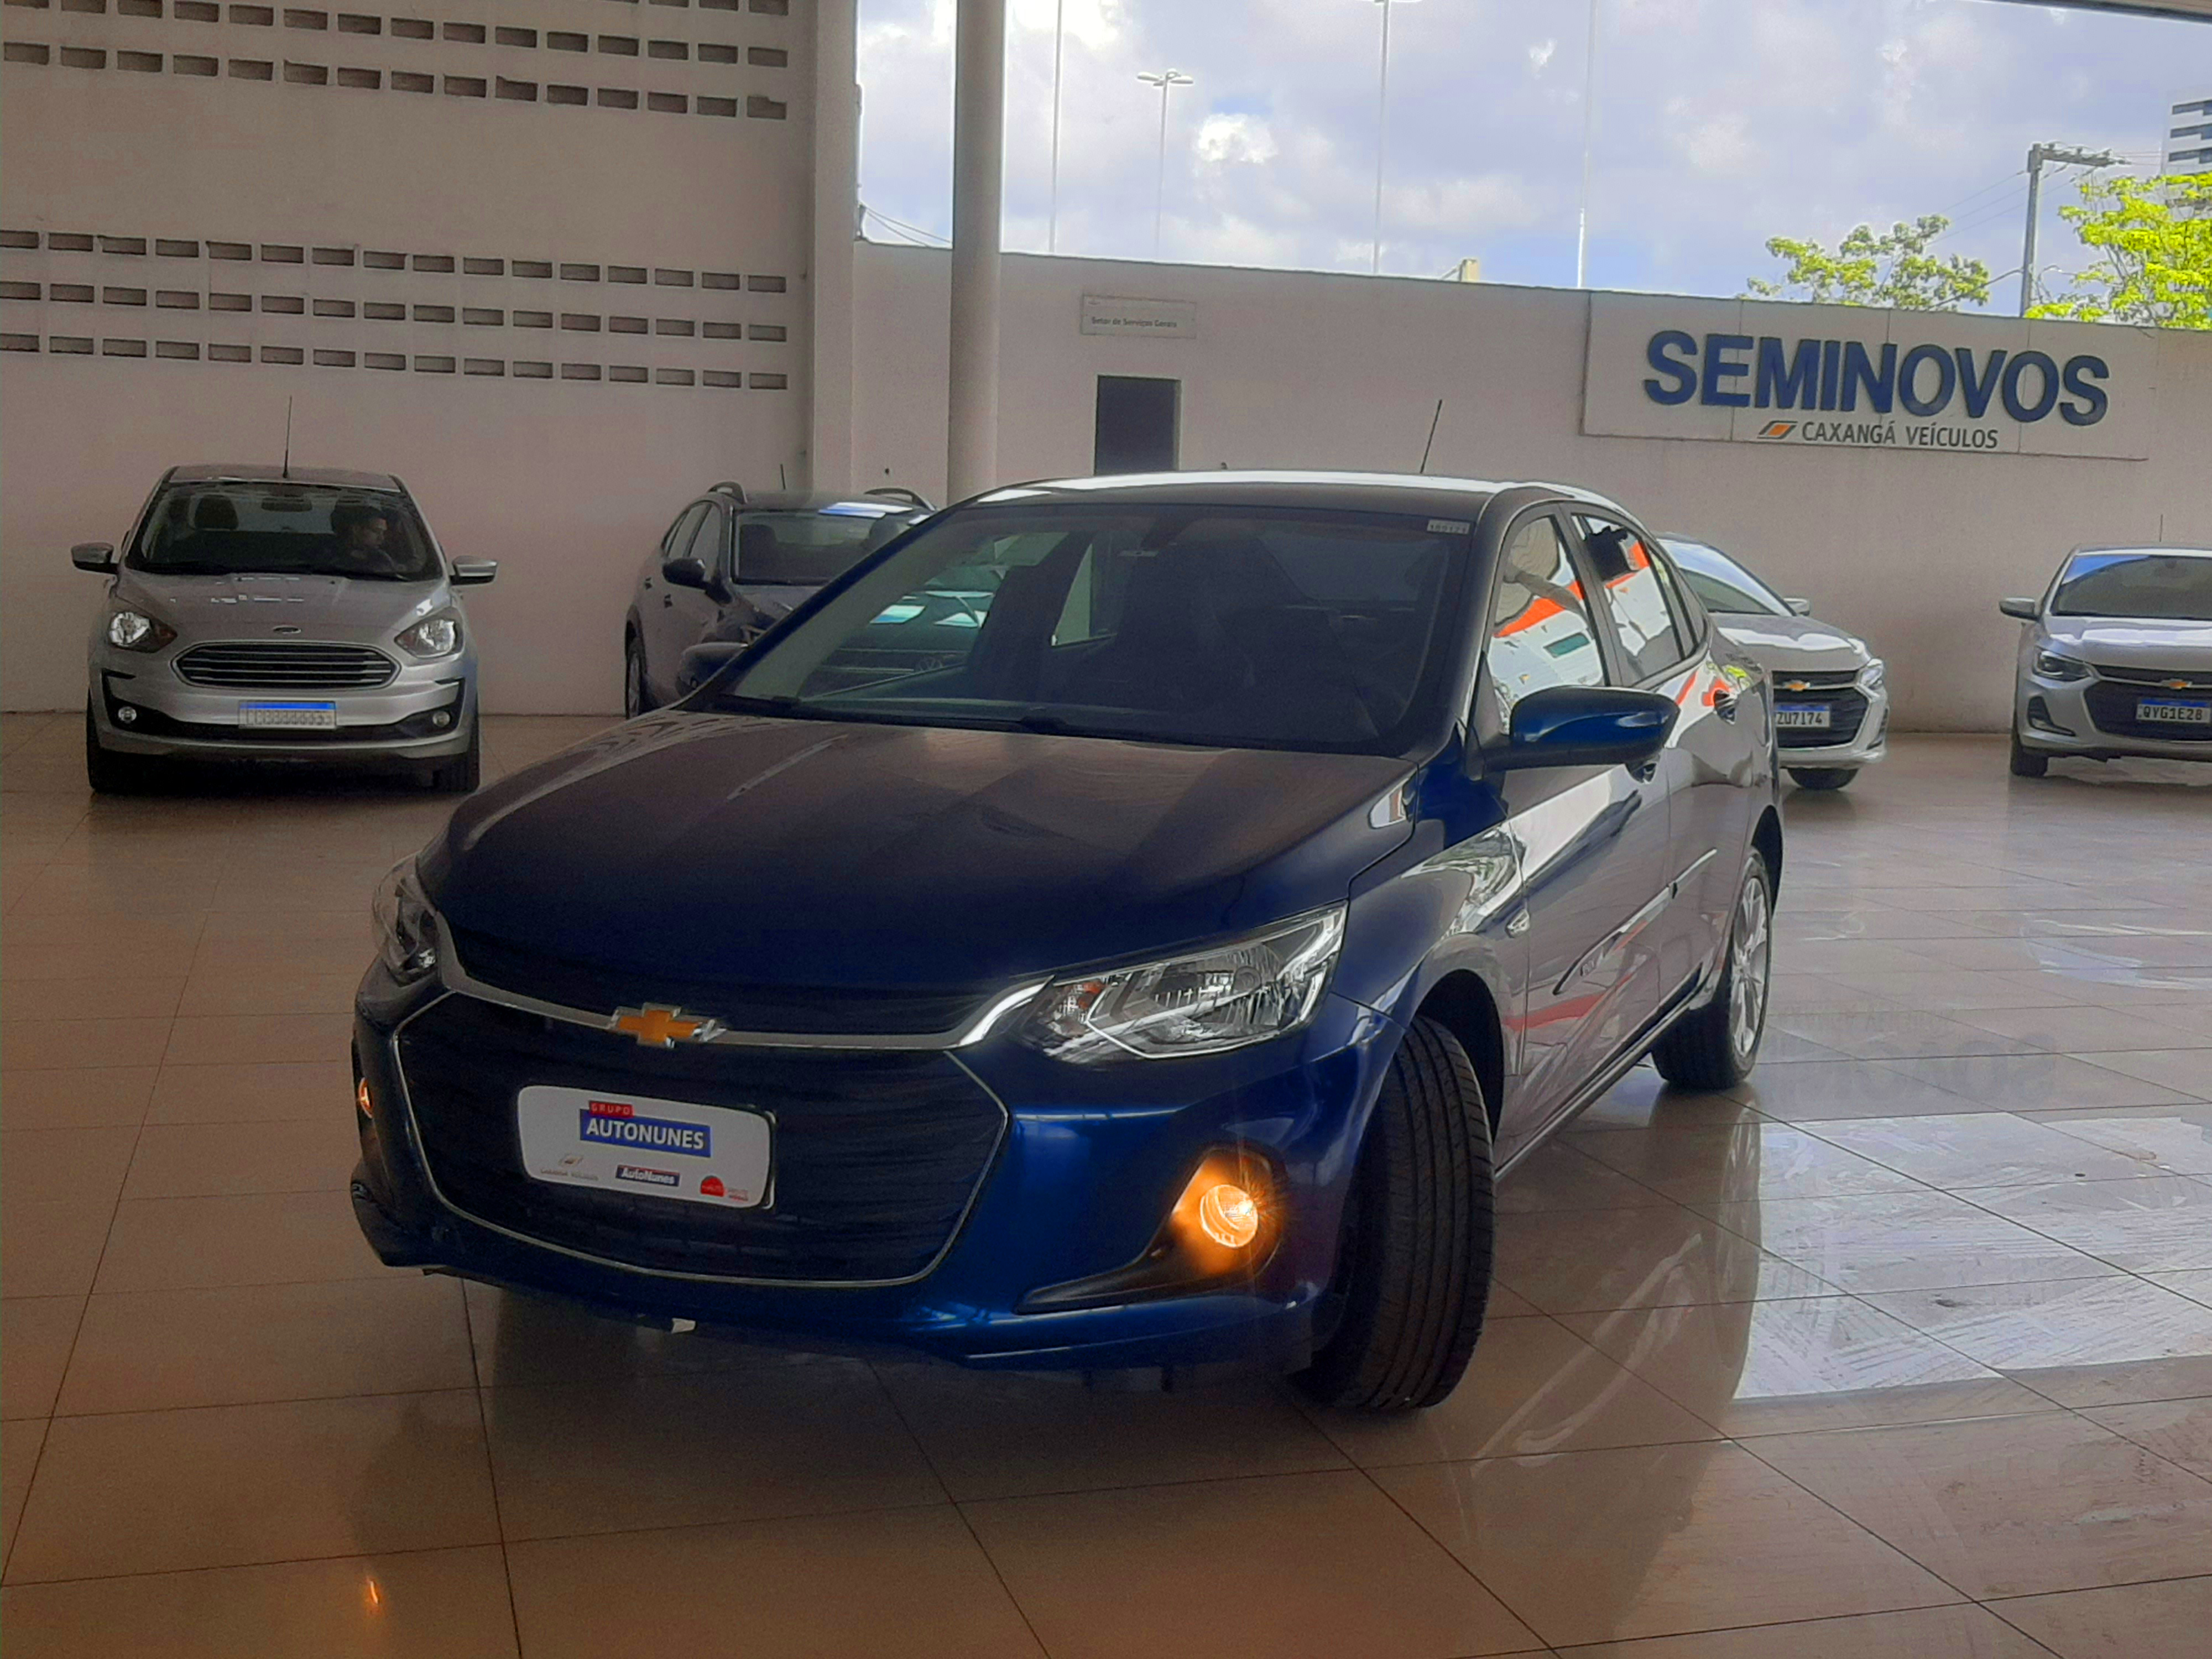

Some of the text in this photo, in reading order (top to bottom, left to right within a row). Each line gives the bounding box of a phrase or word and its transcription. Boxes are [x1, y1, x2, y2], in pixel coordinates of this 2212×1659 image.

[1091, 316, 1111, 325] Setor
[1112, 317, 1121, 326] de
[1643, 330, 2110, 426] SEMINOVOS
[1802, 419, 1999, 449] CAXANGÁ VEÍCULOS
[591, 1103, 630, 1115] GRUPO
[586, 1117, 705, 1150] AUTONUNES
[620, 1167, 675, 1185] AutoNunes
